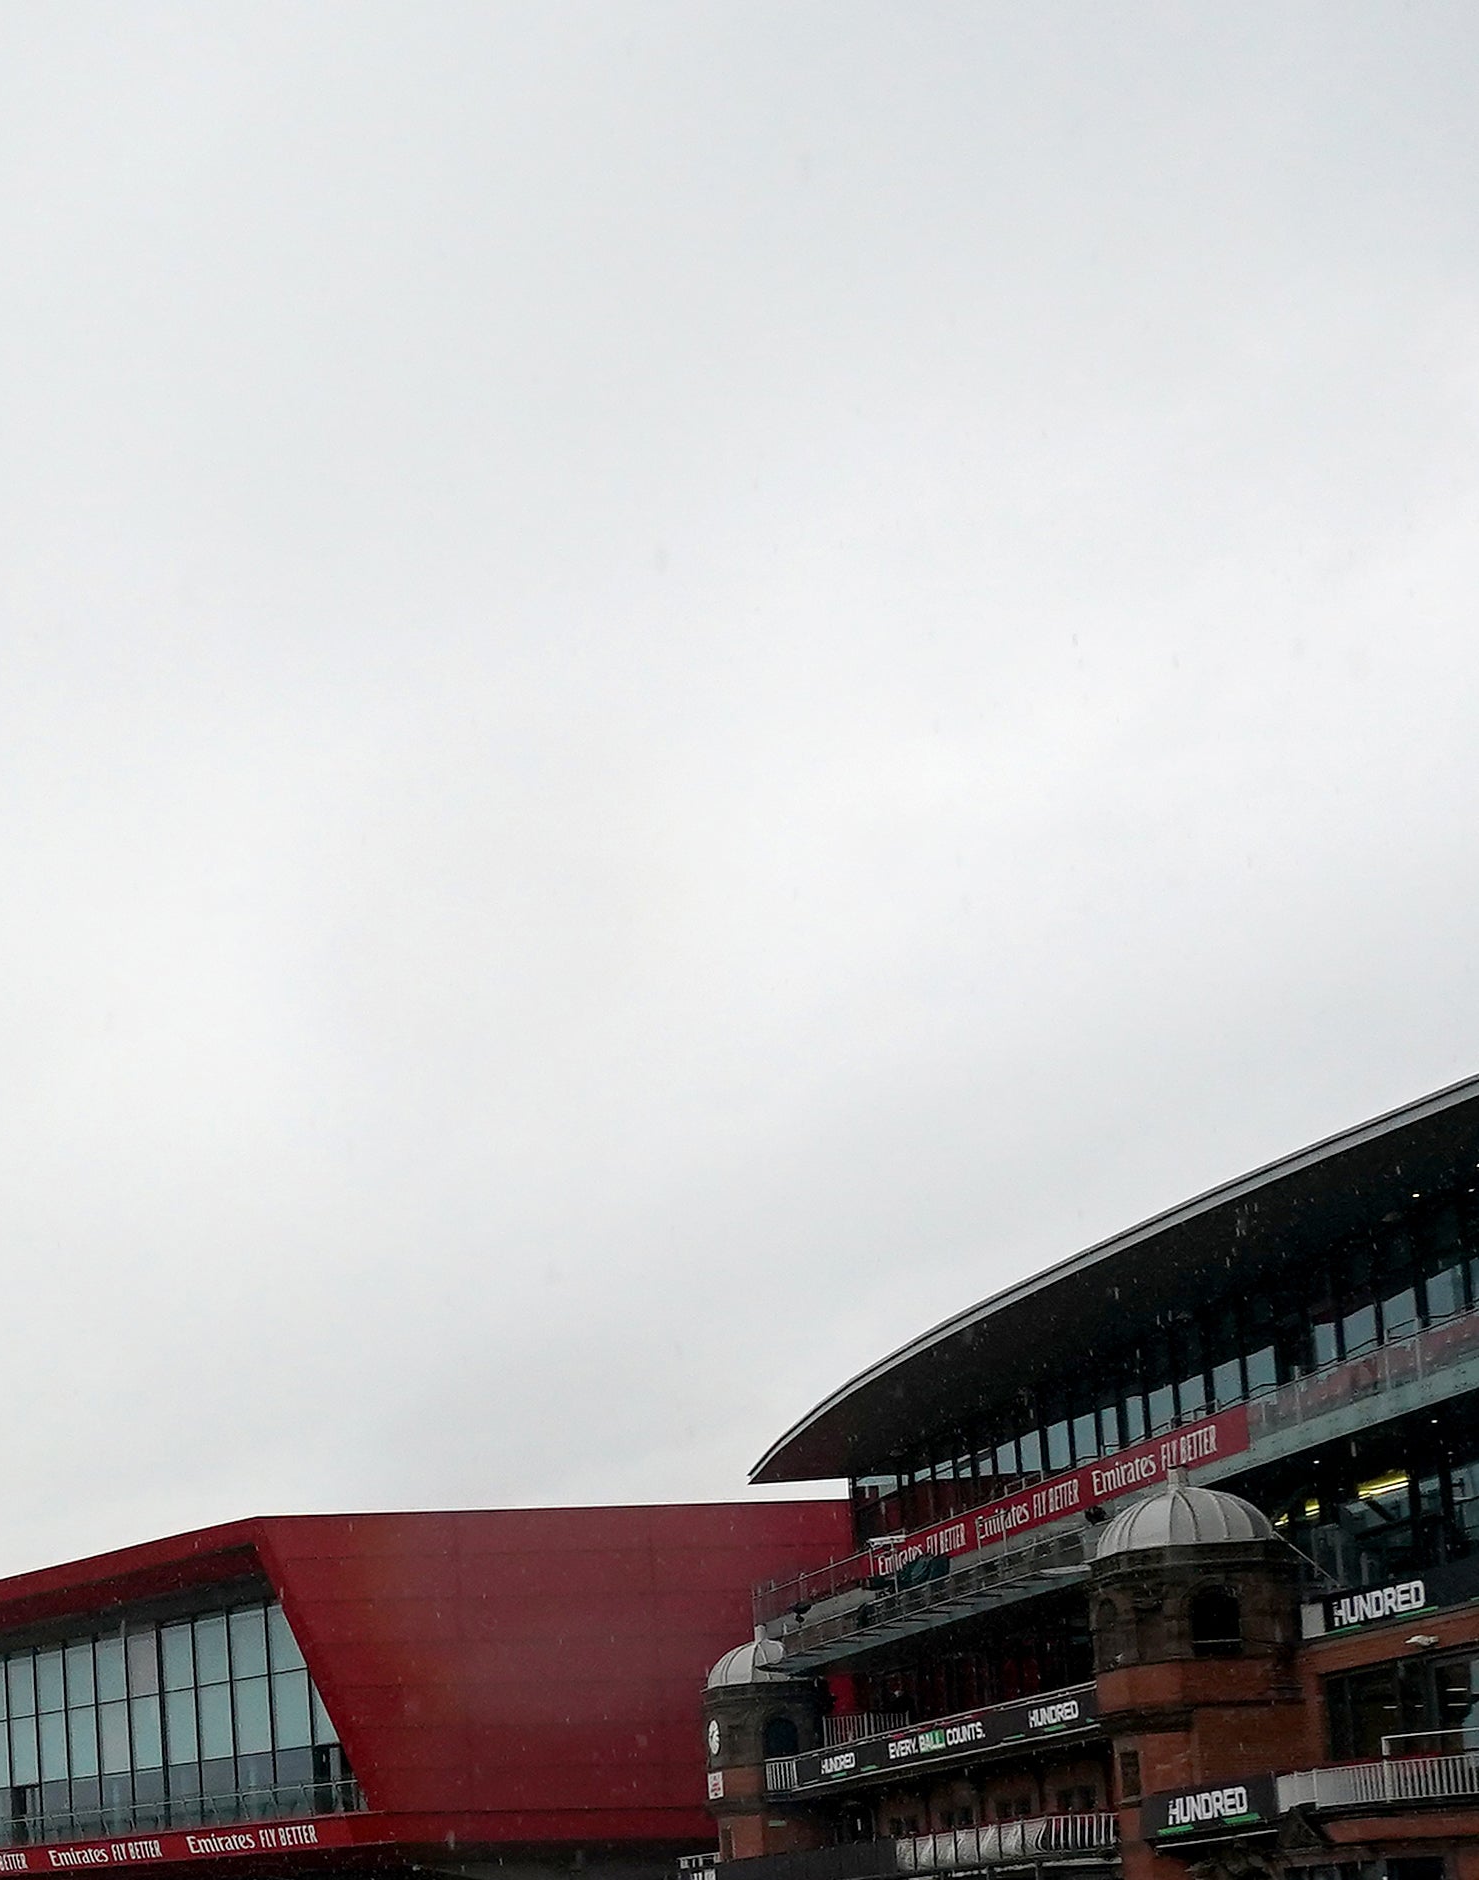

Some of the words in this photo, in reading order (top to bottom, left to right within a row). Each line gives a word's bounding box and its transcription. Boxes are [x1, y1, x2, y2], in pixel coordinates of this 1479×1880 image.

[1092, 1452, 1157, 1496] Emirates
[1160, 1441, 1177, 1471] FLY
[1179, 1425, 1218, 1463] BETTER
[1047, 1479, 1081, 1513] BETTER
[1333, 1579, 1427, 1627] HUNDRED
[1028, 1700, 1079, 1728] HUNDRED
[888, 1738, 919, 1760] EVERY.
[946, 1721, 986, 1746] COUNTS.
[821, 1752, 856, 1775] HUNDRED
[1167, 1785, 1248, 1826] HUNDRED
[47, 1844, 110, 1868] Emirates
[112, 1842, 129, 1862] FLY
[129, 1839, 163, 1860] BETTER
[186, 1831, 256, 1855] Emirates
[259, 1828, 279, 1848] FLY
[278, 1824, 319, 1846] BETTER
[0, 1852, 29, 1872] BETTER
